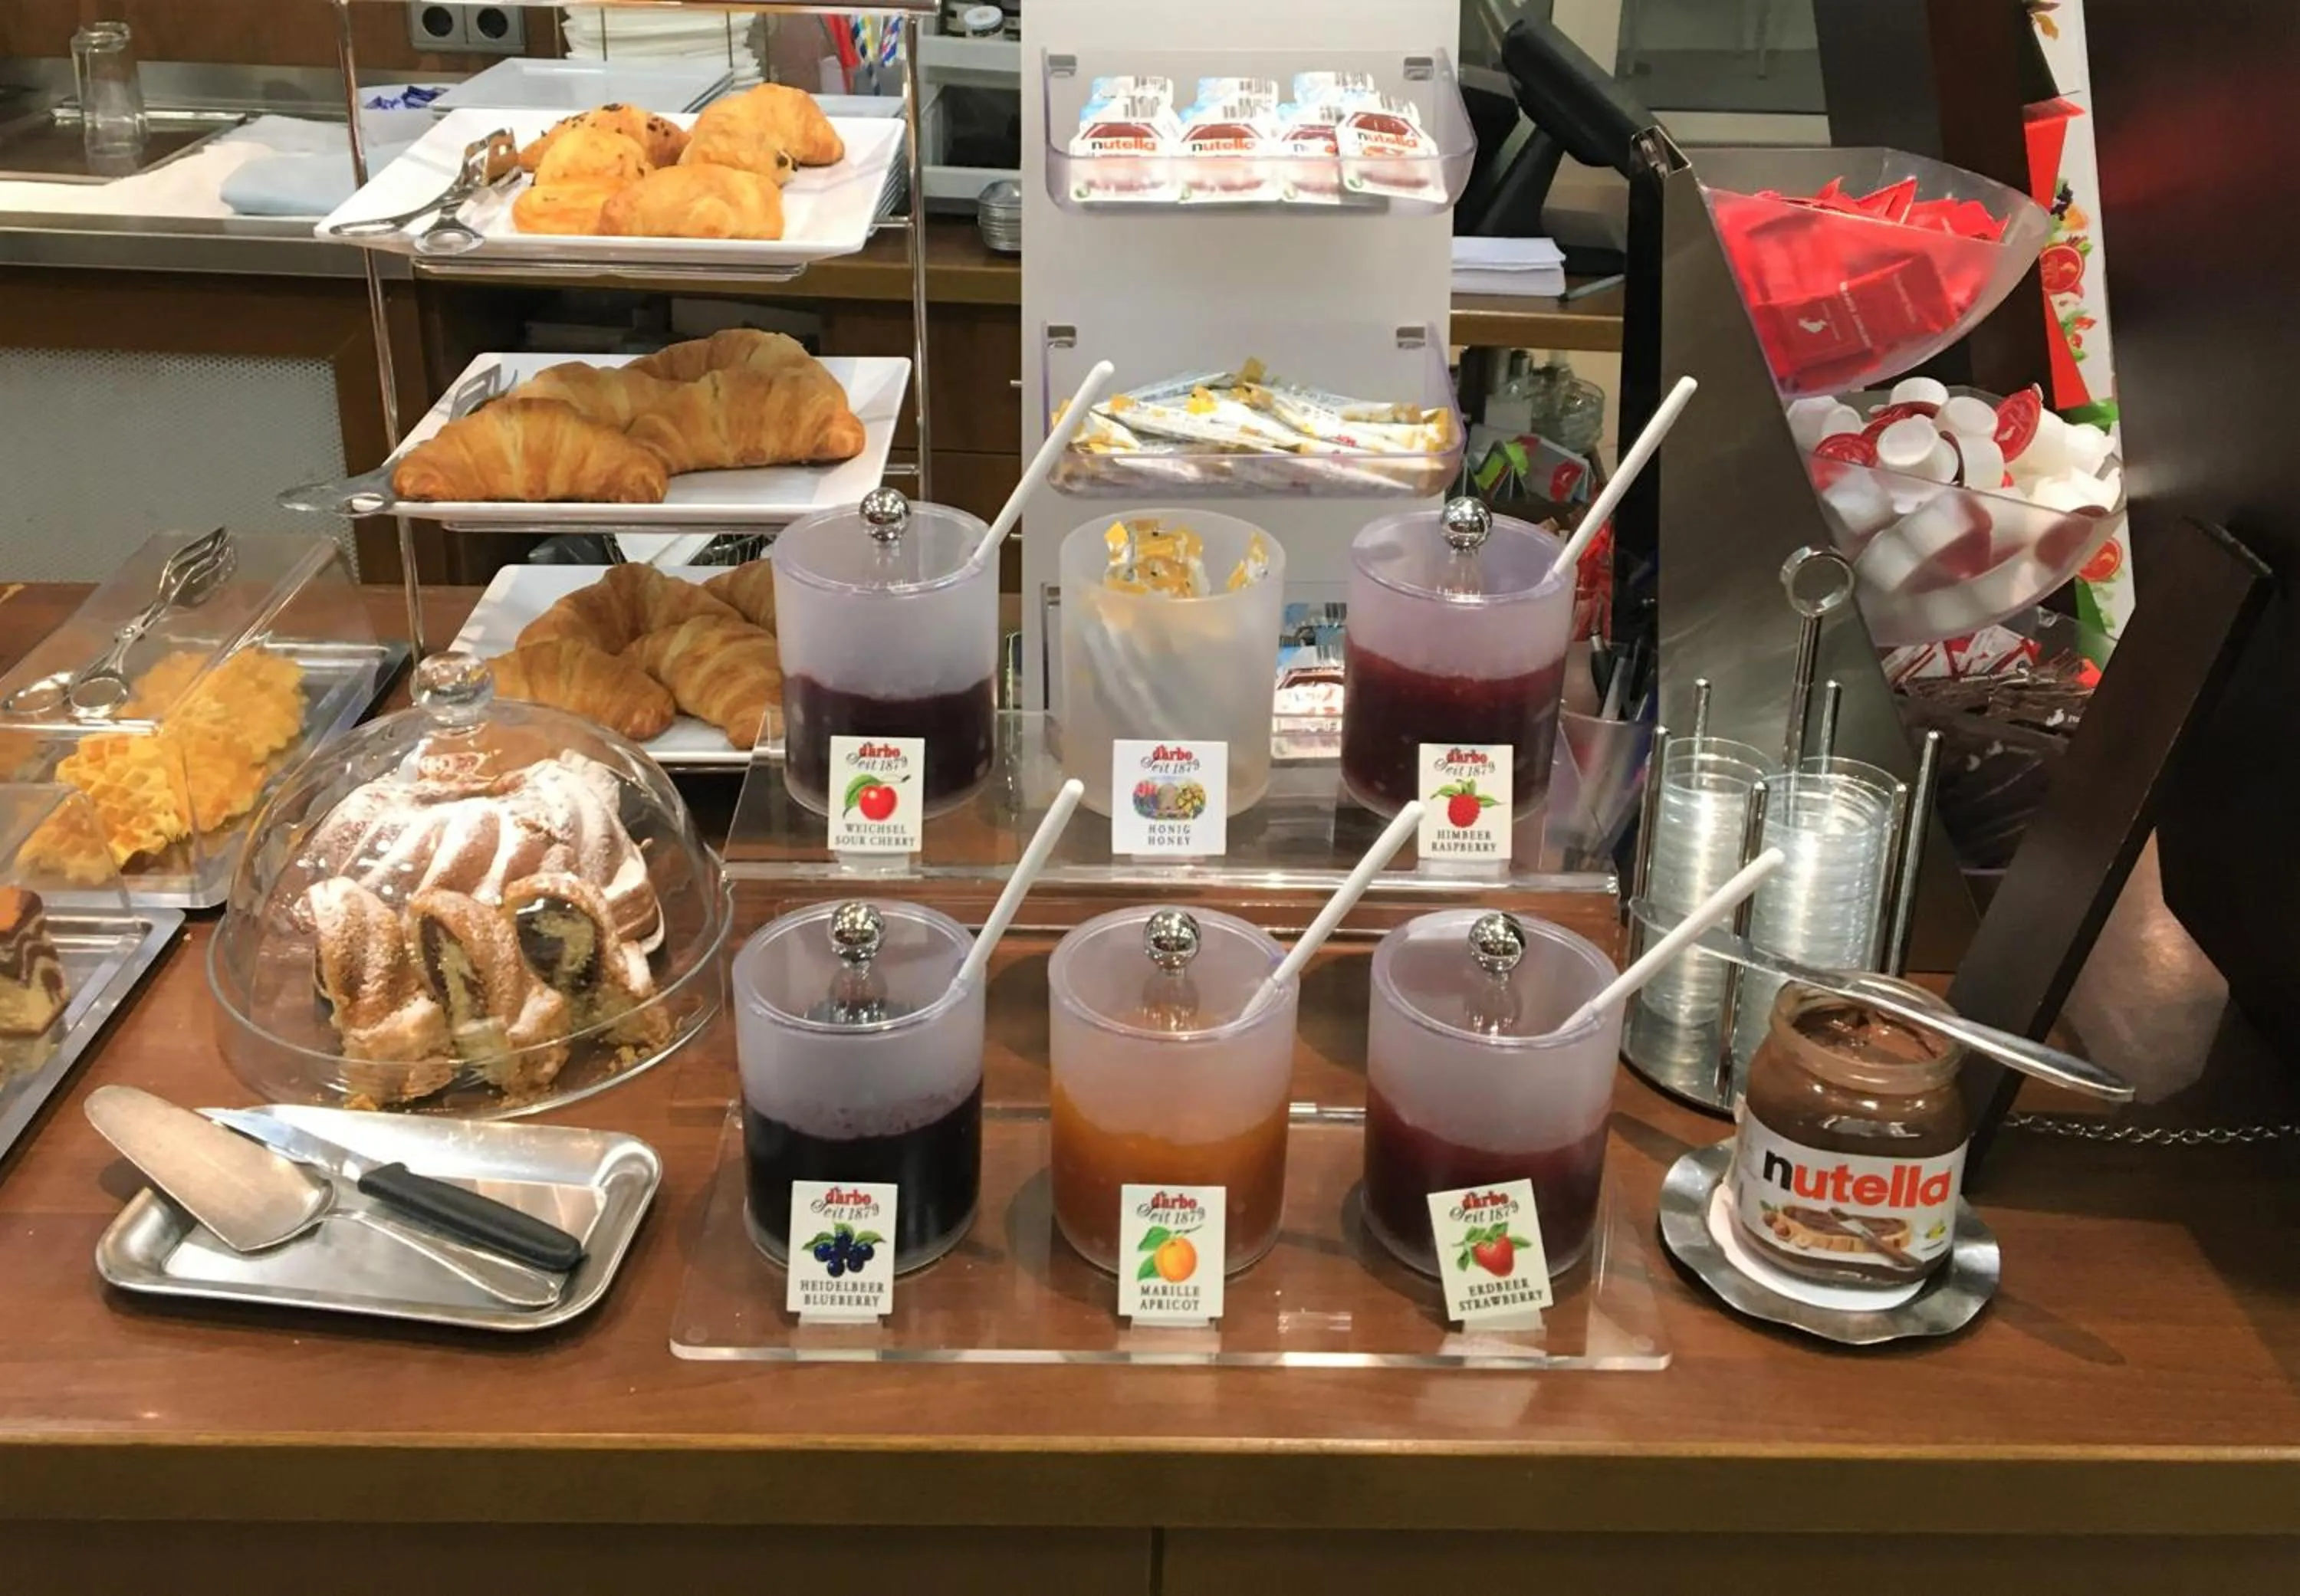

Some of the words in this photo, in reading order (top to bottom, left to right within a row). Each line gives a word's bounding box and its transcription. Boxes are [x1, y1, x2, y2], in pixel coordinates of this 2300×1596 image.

[845, 823, 907, 834] WEICHSEL
[1148, 824, 1191, 834] HONIG
[1437, 829, 1491, 840] HIMBEER
[835, 835, 866, 846] SOUR
[869, 836, 915, 847] CHERRY
[1148, 836, 1191, 846] HONEY
[1431, 842, 1497, 852] RASPBERRY
[1763, 1149, 1952, 1208] nutella
[800, 1280, 884, 1293] HEIDELBEER
[1140, 1286, 1200, 1296] MARILLE
[1467, 1277, 1530, 1296] ERDBEER
[803, 1294, 881, 1306] BLUEBERRY
[1140, 1299, 1200, 1311] APRICOT
[1459, 1289, 1544, 1312] STRAWBERRY
